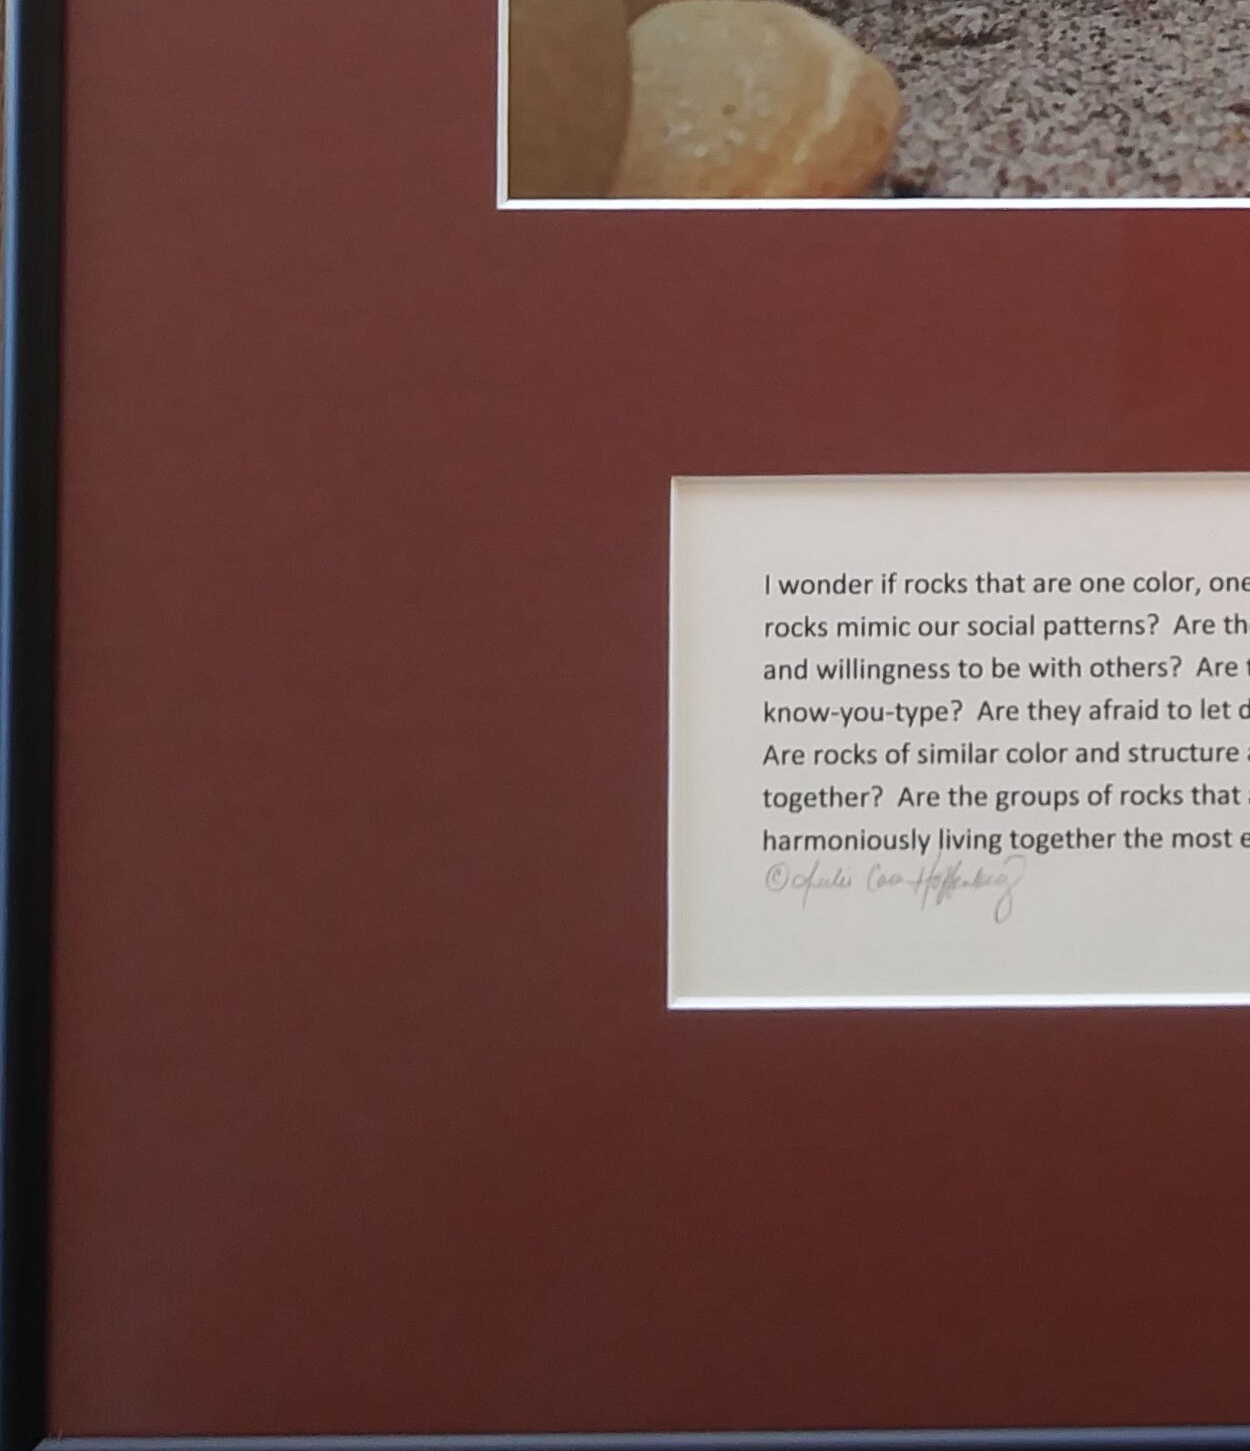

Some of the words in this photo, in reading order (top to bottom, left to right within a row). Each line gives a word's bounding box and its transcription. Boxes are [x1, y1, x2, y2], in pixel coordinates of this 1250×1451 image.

[765, 573, 771, 596] I
[777, 572, 874, 596] wonder
[881, 571, 898, 595] if
[904, 571, 968, 595] rocks
[975, 571, 1026, 595] that
[1032, 576, 1073, 594] are
[1079, 576, 1126, 594] one
[1132, 570, 1201, 597] color,
[764, 614, 829, 639] rocks
[836, 615, 911, 638] mimic
[917, 620, 961, 637] our
[966, 613, 1035, 637] social
[1043, 612, 1160, 642] patterns?
[1172, 614, 1216, 636] Are
[763, 657, 808, 681] and
[816, 657, 951, 686] willingness
[957, 659, 984, 680] to
[991, 656, 1021, 679] be
[1027, 655, 1082, 679] with
[1089, 654, 1183, 679] others?
[1195, 656, 1239, 678] Are
[763, 699, 964, 729] know-you-type?
[976, 700, 1020, 722] Are
[1026, 698, 1082, 727] they
[1088, 697, 1159, 721] afraid
[1166, 700, 1193, 721] to
[1200, 697, 1232, 721] let
[762, 744, 806, 766] Are
[813, 742, 878, 766] rocks
[884, 741, 912, 766] of
[917, 741, 1000, 765] similar
[1005, 741, 1069, 765] color
[1075, 740, 1120, 764] and
[1127, 743, 1240, 764] structure
[762, 784, 884, 814] together?
[896, 786, 941, 808] Are
[947, 784, 989, 808] the
[995, 789, 1080, 813] groups
[1087, 783, 1114, 807] of
[1119, 783, 1184, 807] rocks
[1190, 782, 1242, 806] that
[762, 827, 932, 856] harmoniously
[938, 827, 1003, 856] living
[1009, 826, 1117, 855] together
[1122, 826, 1164, 850] the
[1171, 828, 1234, 849] most
